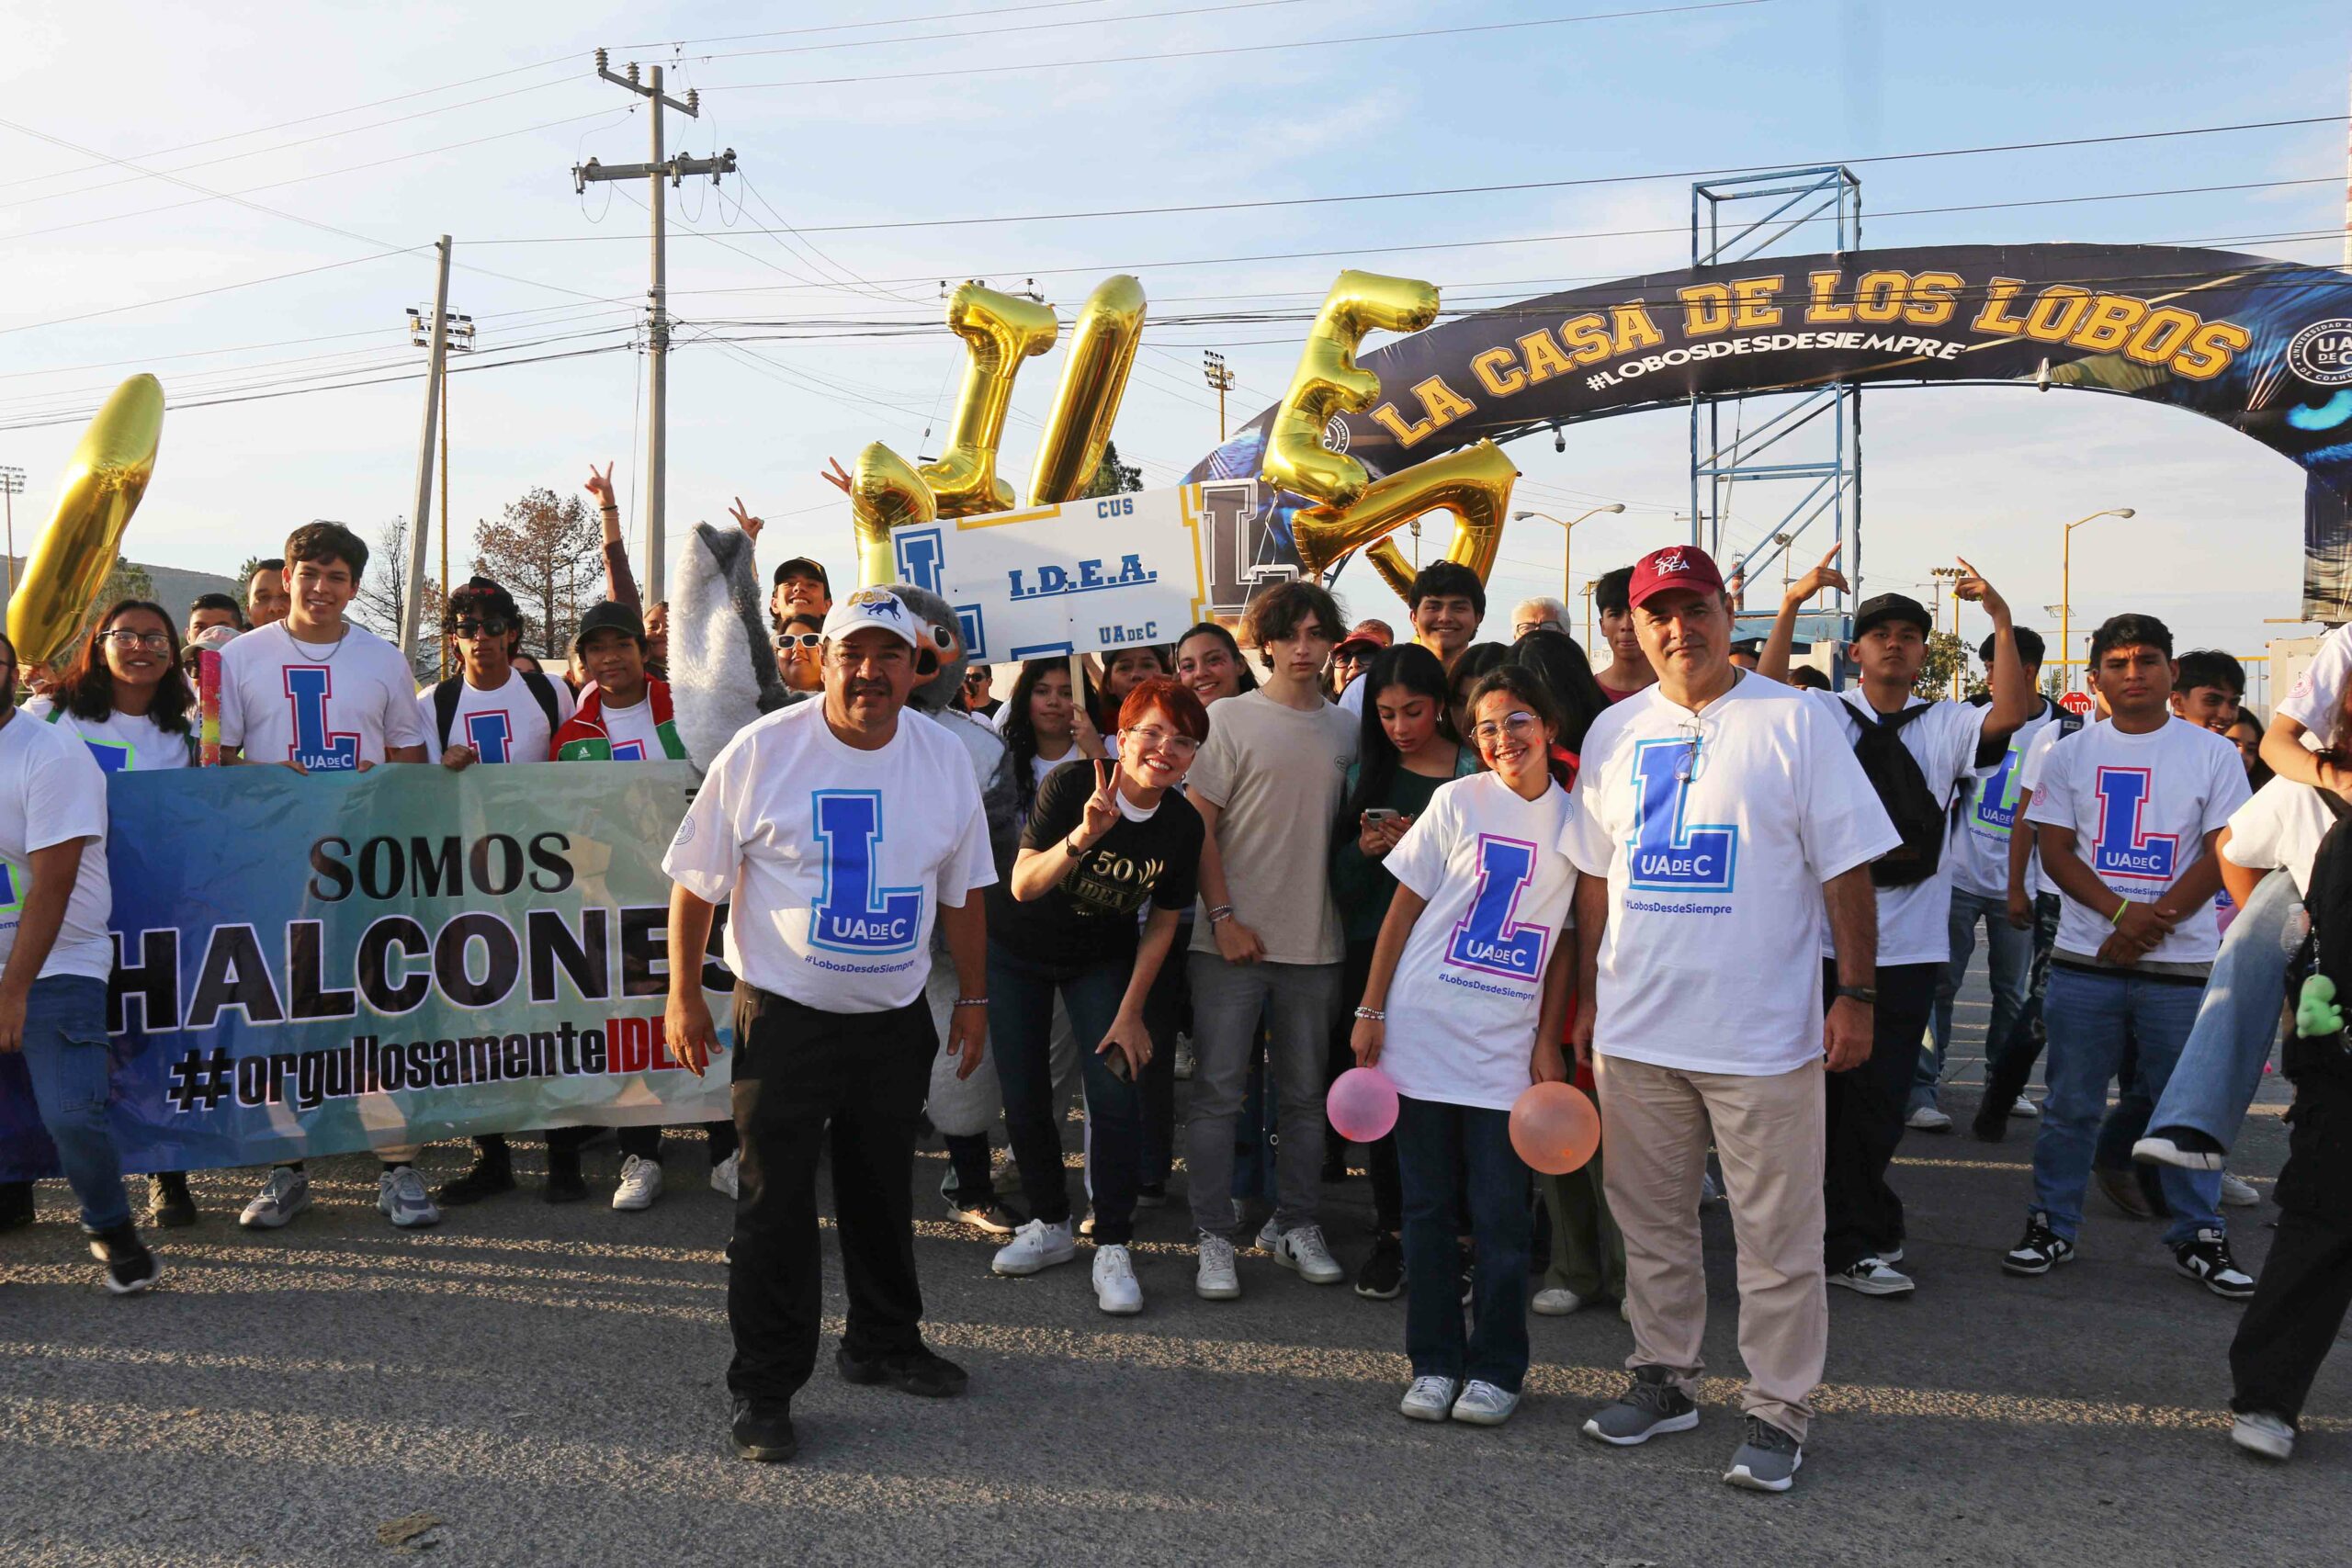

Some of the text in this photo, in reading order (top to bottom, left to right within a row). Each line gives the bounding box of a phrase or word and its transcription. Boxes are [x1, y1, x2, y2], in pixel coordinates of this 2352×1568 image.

[2293, 322, 2342, 359] UNIVERSIDAD
[1369, 269, 2252, 449] LA CASA DE LOS LOBOS
[1586, 332, 1966, 391] #LOBOSDESDESIEMPRE
[1098, 499, 1134, 519] CUS
[1009, 553, 1158, 599] I.D.E.A.
[1657, 560, 1690, 577] IDEA
[2063, 701, 2089, 714] ALTO
[309, 831, 575, 903] SOMOS
[1092, 850, 1135, 882] 50
[1075, 879, 1125, 909] IDEA
[1626, 899, 1733, 916] #LobosDesdeSiempre
[805, 954, 915, 974] #LobosDesdeSiempre
[1438, 972, 1535, 1001] #LobosDesdeSiempre
[166, 1015, 710, 1113] #orgullosamenteIDE
